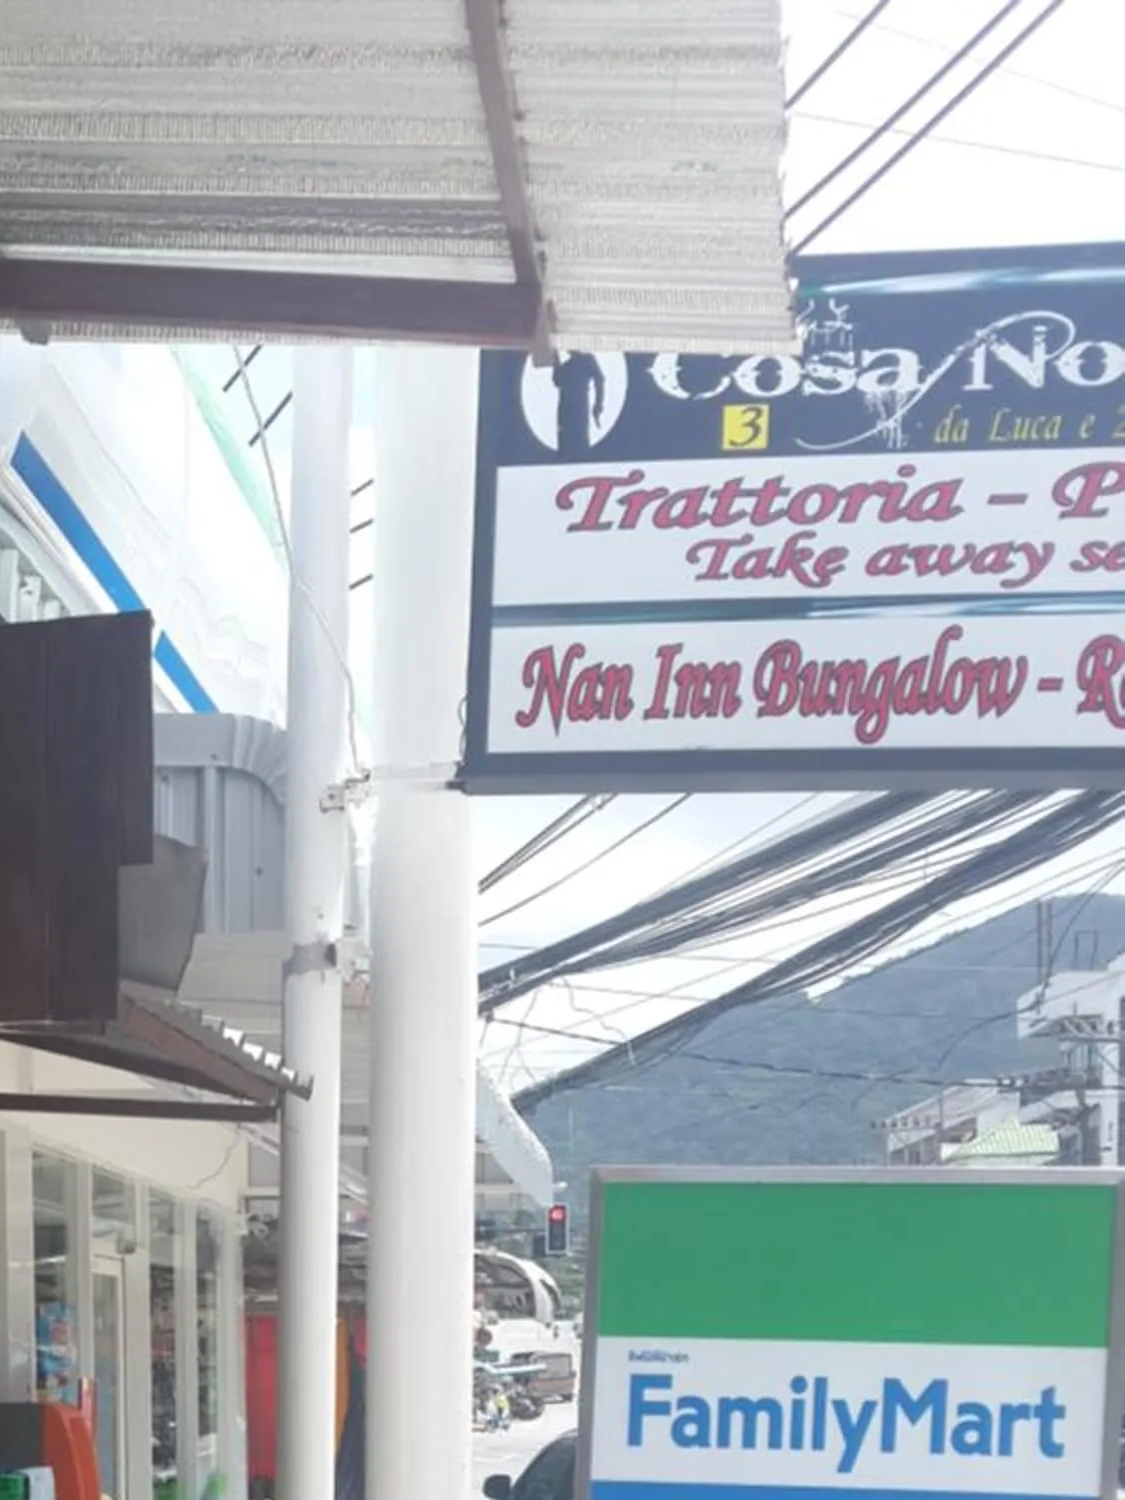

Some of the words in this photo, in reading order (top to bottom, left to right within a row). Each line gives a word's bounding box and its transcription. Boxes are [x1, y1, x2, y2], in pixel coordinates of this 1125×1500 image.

[646, 348, 924, 401] Cosa
[728, 405, 765, 447] 3
[933, 402, 970, 444] da
[987, 406, 1063, 442] Luca
[1078, 412, 1097, 440] e
[555, 464, 965, 533] Trattoria
[685, 531, 850, 588] Take
[864, 540, 1056, 588] away
[515, 642, 635, 737] Nan
[643, 642, 743, 721] Inn
[752, 625, 1029, 745] Bungalow
[1076, 634, 1125, 730] R
[626, 1373, 1067, 1474] FamilyMart
